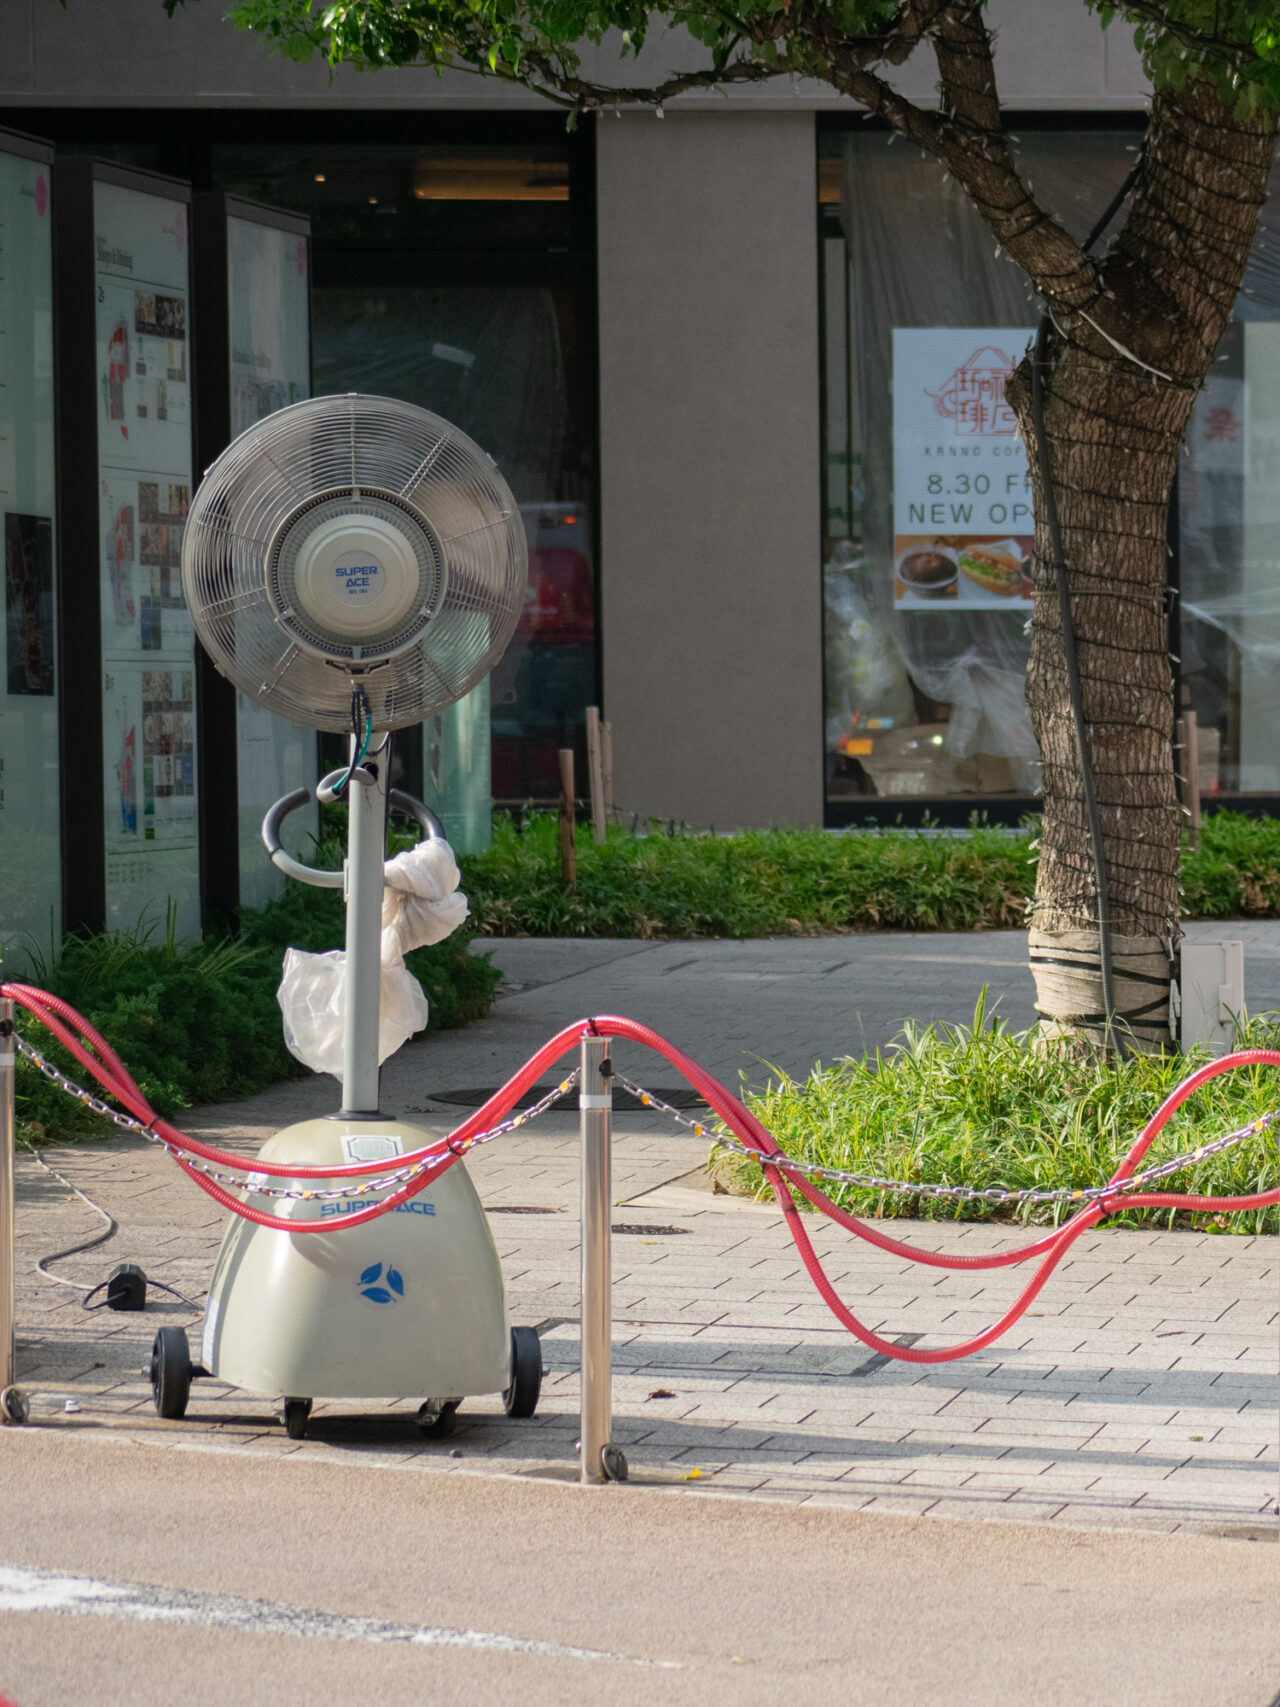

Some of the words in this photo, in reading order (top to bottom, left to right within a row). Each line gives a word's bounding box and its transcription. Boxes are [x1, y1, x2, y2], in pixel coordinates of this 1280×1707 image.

[925, 446, 981, 456] KANNO
[993, 446, 1023, 456] COF
[927, 474, 991, 495] 8.30
[909, 503, 973, 524] NEW
[989, 503, 1028, 524] OP
[335, 566, 378, 577] SUPER
[346, 577, 370, 588] ACE
[320, 1200, 394, 1217] SUP
